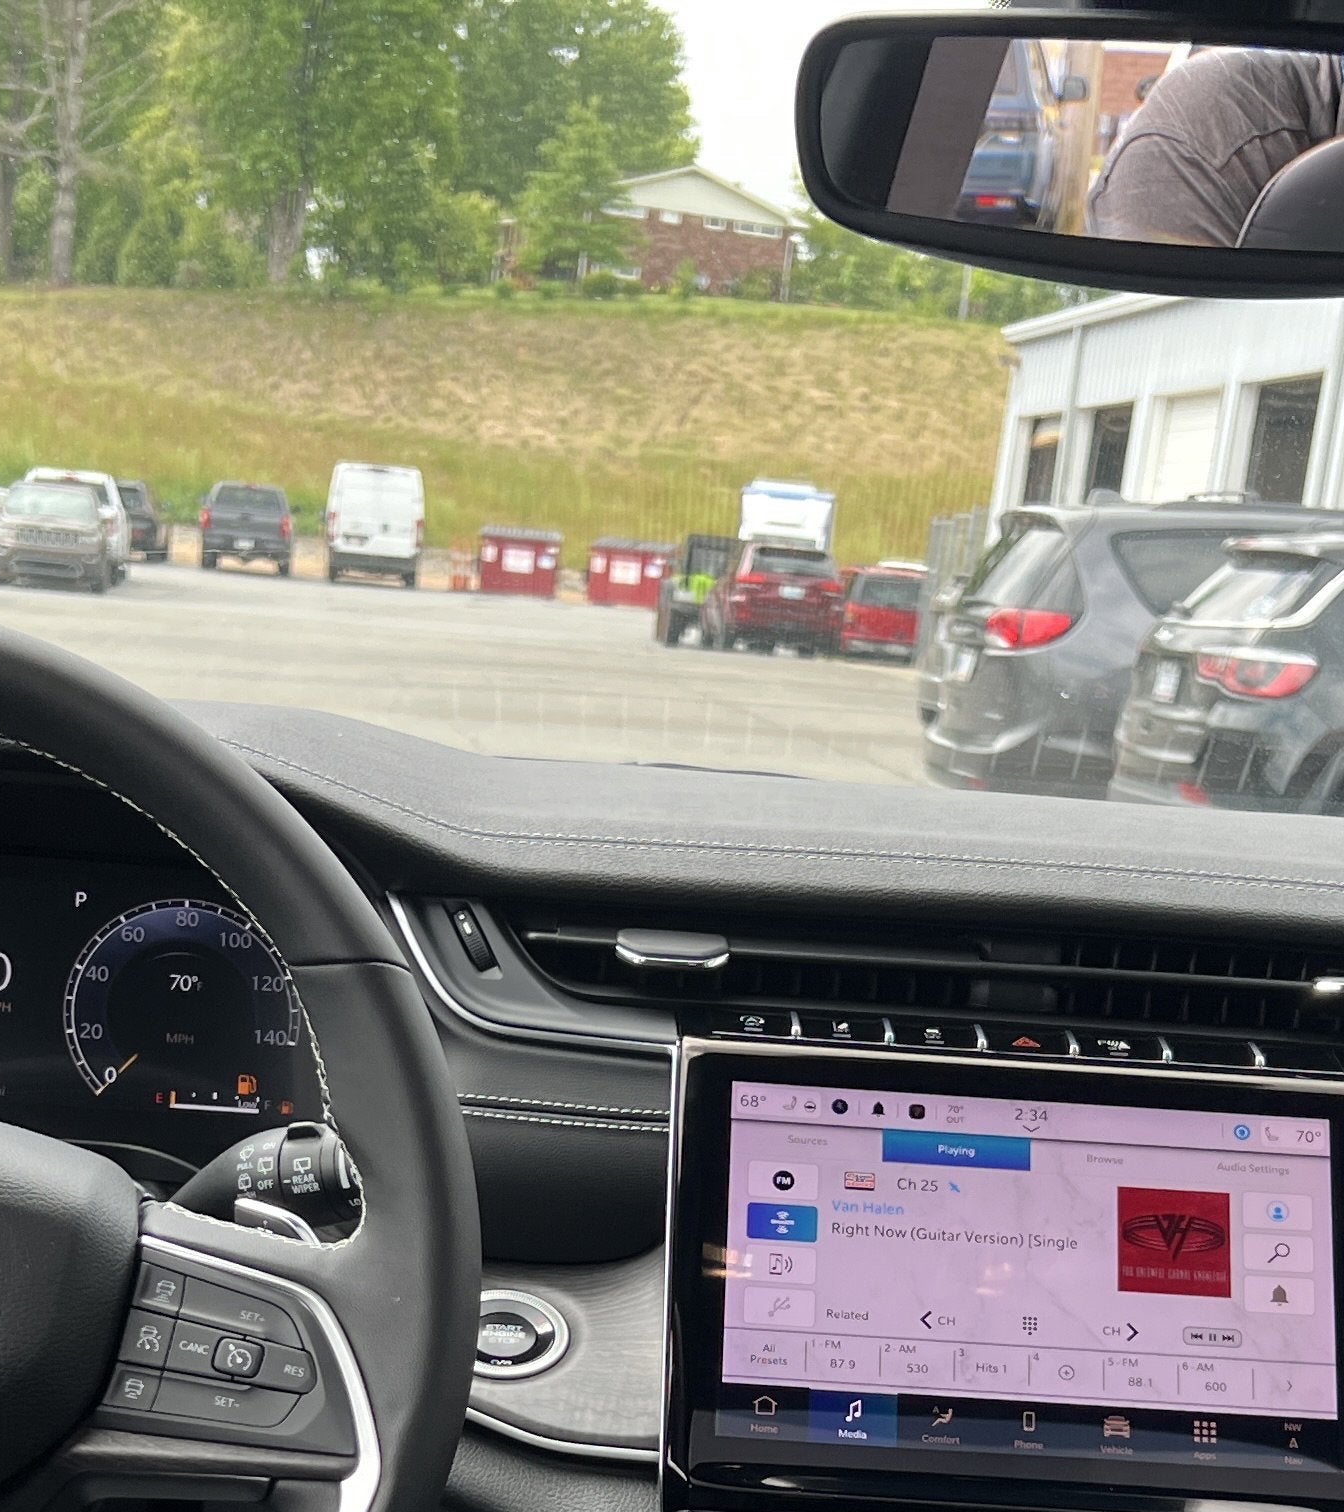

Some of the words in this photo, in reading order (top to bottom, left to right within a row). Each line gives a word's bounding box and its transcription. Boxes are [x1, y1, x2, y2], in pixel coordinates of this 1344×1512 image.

[75, 892, 87, 907] P
[175, 911, 199, 928] 80
[121, 926, 145, 943] 60
[219, 932, 252, 949] 100
[86, 965, 109, 983] 40
[252, 975, 284, 993] 120
[80, 1022, 103, 1040] 20
[166, 1032, 194, 1045] MPH
[255, 1029, 287, 1046] 140
[105, 1066, 118, 1083] 0
[155, 1092, 163, 1104] E
[1014, 1108, 1049, 1122] 2:34
[787, 1135, 828, 1147] Sources
[937, 1144, 976, 1158] Playing
[1086, 1153, 1124, 1166] Browse
[1216, 1161, 1247, 1173] Audio
[1249, 1163, 1290, 1176] Settings
[258, 1179, 274, 1190] OFF
[292, 1174, 315, 1185] REAR
[776, 1176, 792, 1185] FM
[897, 1178, 916, 1191] Ch
[919, 1179, 938, 1193] 25
[292, 1183, 321, 1194] WIPER
[832, 1200, 859, 1213] Van
[863, 1202, 905, 1216] Halen
[831, 1223, 870, 1238] Right
[874, 1225, 907, 1239] Now
[910, 1226, 961, 1243] (Guitar
[965, 1230, 1024, 1249] Version)
[826, 1308, 870, 1321] Related
[486, 1323, 523, 1331] START
[937, 1315, 956, 1327] CH
[1102, 1326, 1121, 1337] CH
[179, 1340, 209, 1355] CANC
[762, 1343, 776, 1353] All
[824, 1340, 842, 1350] FM
[898, 1344, 917, 1355] AM
[750, 1354, 788, 1367] Presets
[1122, 1358, 1139, 1368] FM
[284, 1365, 305, 1378] RES
[906, 1363, 929, 1374] 530
[976, 1363, 999, 1373] Hits
[1196, 1363, 1215, 1373] AM
[1128, 1377, 1153, 1388] 88.1
[1205, 1382, 1227, 1392] 600
[750, 1424, 779, 1435] Home
[838, 1429, 867, 1440] Media
[922, 1434, 960, 1446] Comfort
[1014, 1440, 1044, 1450] Phone
[1100, 1445, 1134, 1456] Vehicle
[1193, 1451, 1217, 1461] Apps
[1284, 1456, 1303, 1466] Nav
